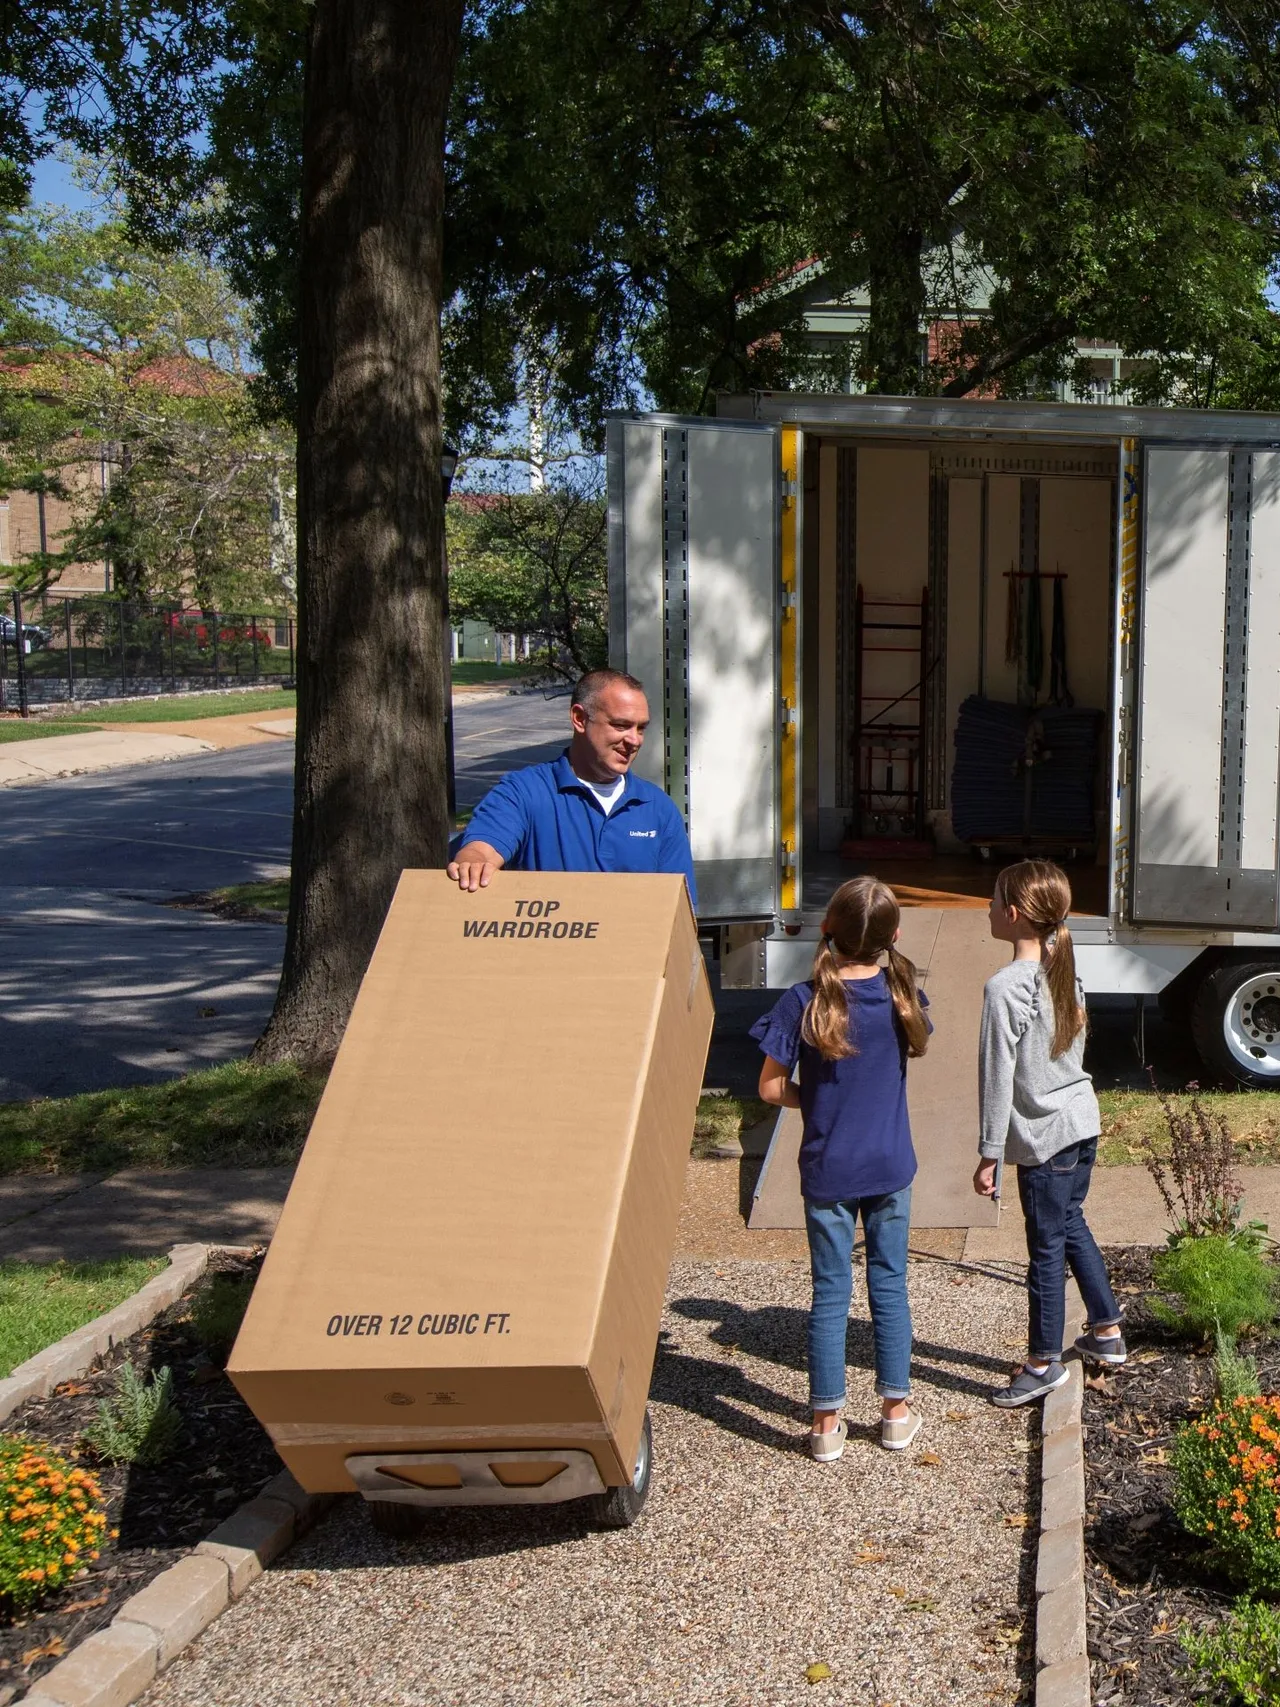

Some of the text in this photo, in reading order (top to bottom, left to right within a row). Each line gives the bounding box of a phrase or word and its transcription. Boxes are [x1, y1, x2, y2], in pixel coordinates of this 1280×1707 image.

[515, 900, 560, 918] TOP
[463, 920, 600, 939] WARDROBE
[326, 1313, 511, 1336] OVER 12 CUBIC FT.
